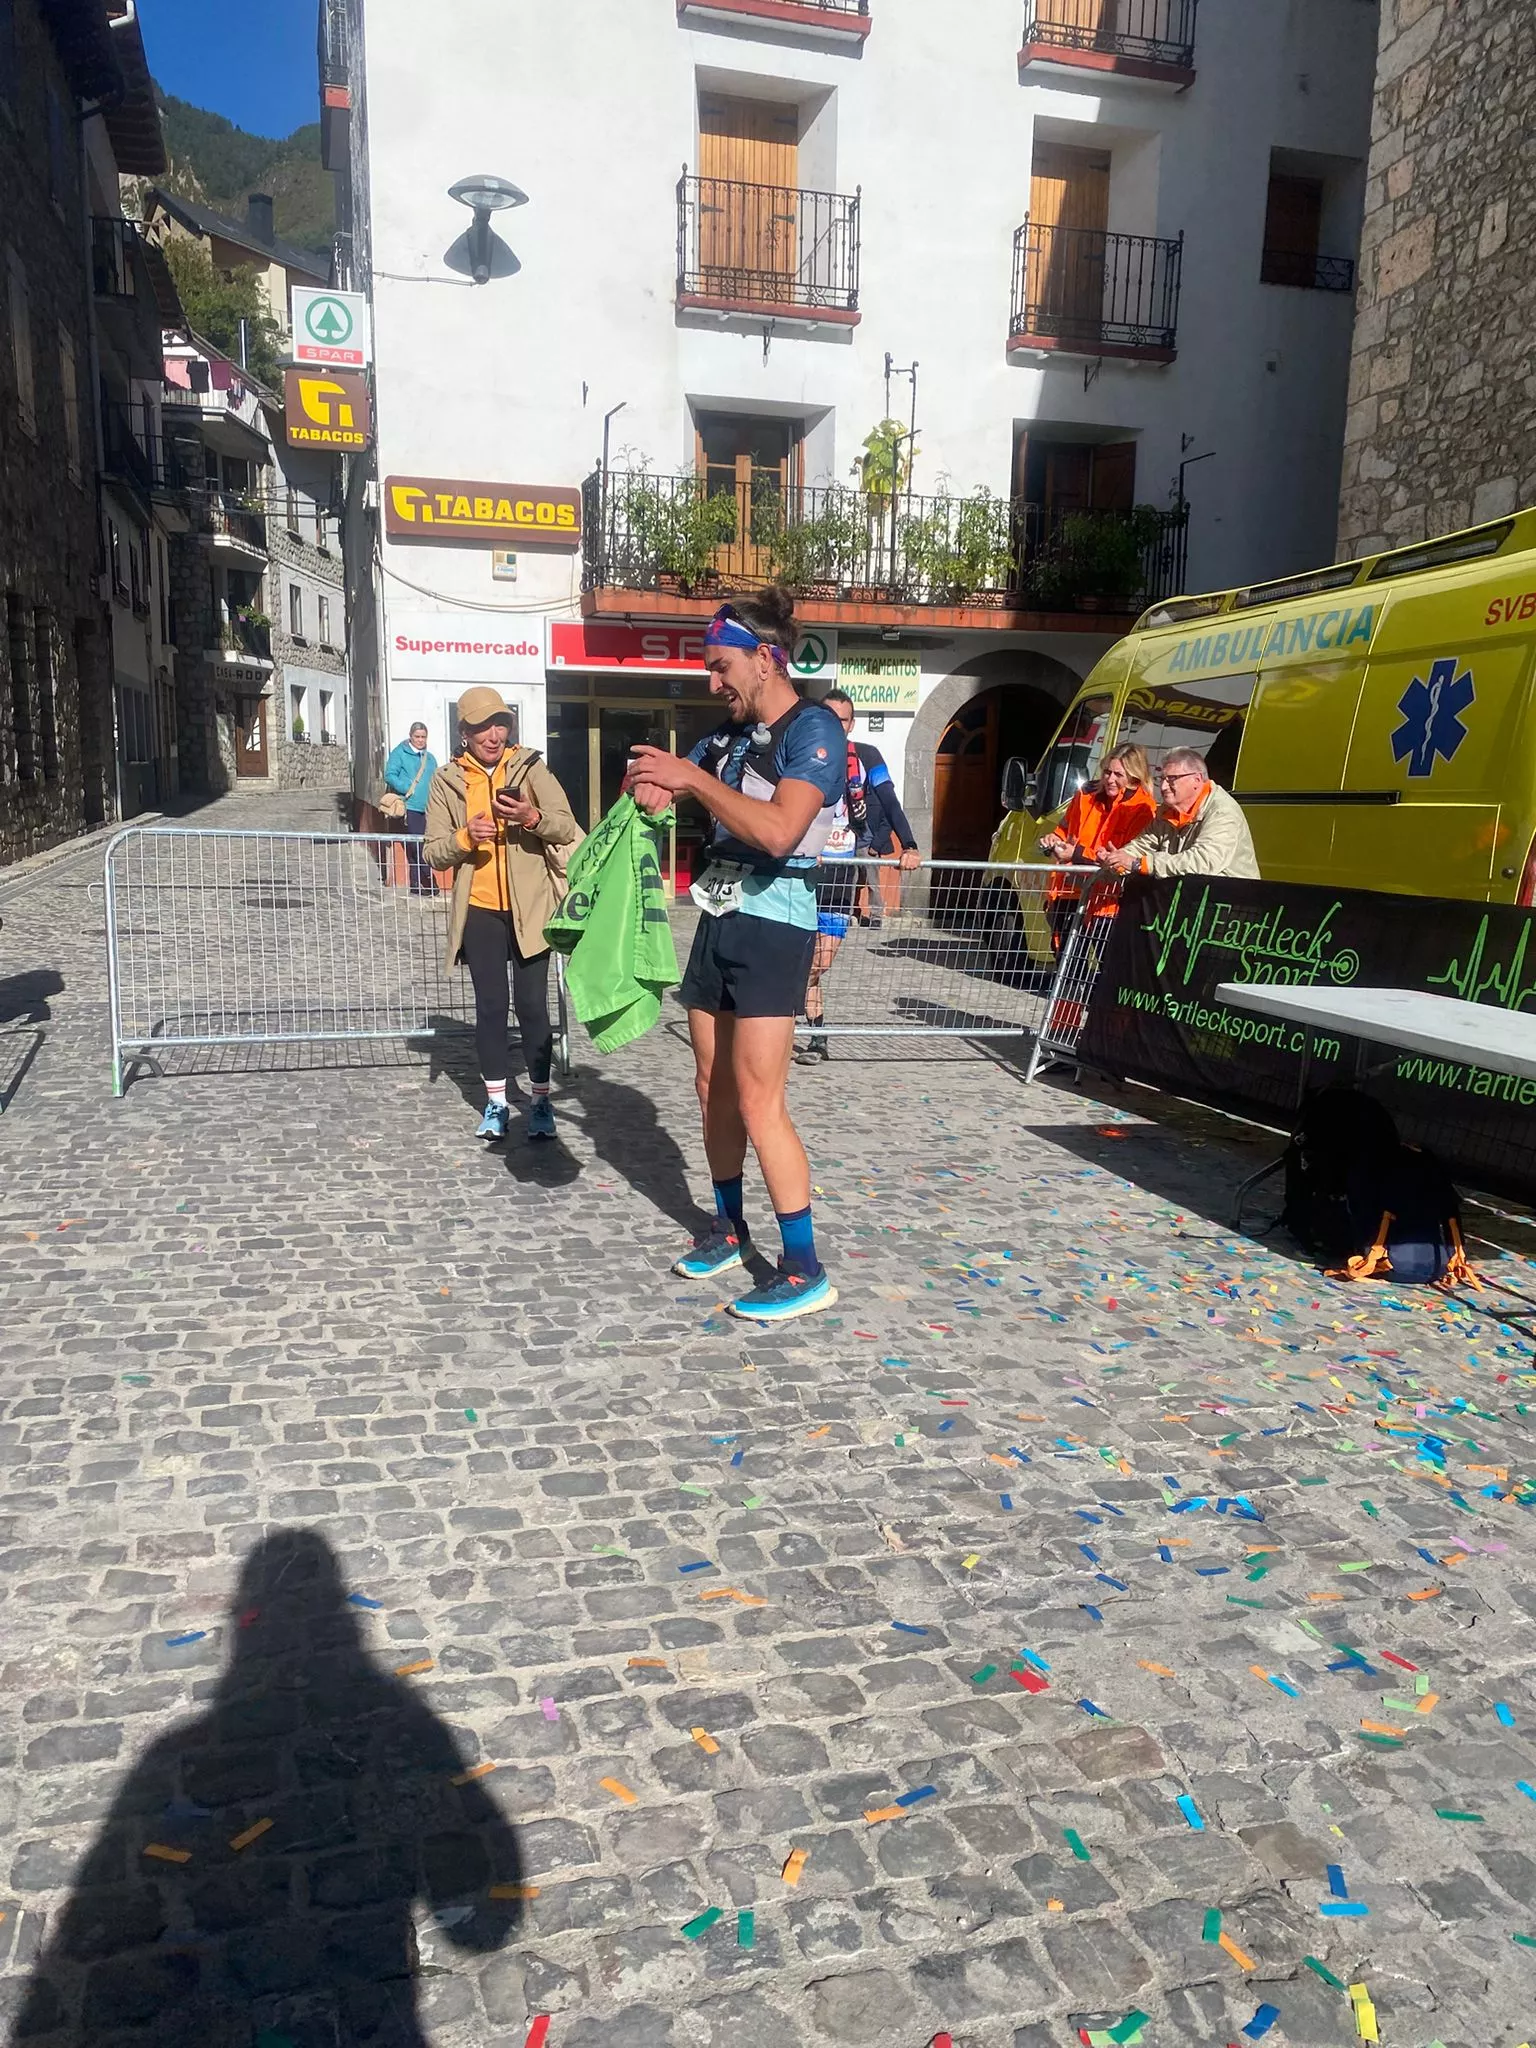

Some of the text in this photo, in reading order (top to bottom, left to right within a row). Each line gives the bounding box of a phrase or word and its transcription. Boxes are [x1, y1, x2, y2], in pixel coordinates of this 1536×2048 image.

[306, 348, 355, 361] SPAR
[290, 427, 364, 444] TABACOS
[435, 494, 575, 526] TABACOS
[1485, 593, 1536, 625] SVB
[395, 635, 539, 656] Supermercado
[1168, 605, 1374, 673] AMBULANCIA
[841, 657, 917, 676] APARTAMENTOS
[1208, 901, 1343, 958] Fartleck
[1117, 986, 1341, 1062] www.fartlecksport.cm
